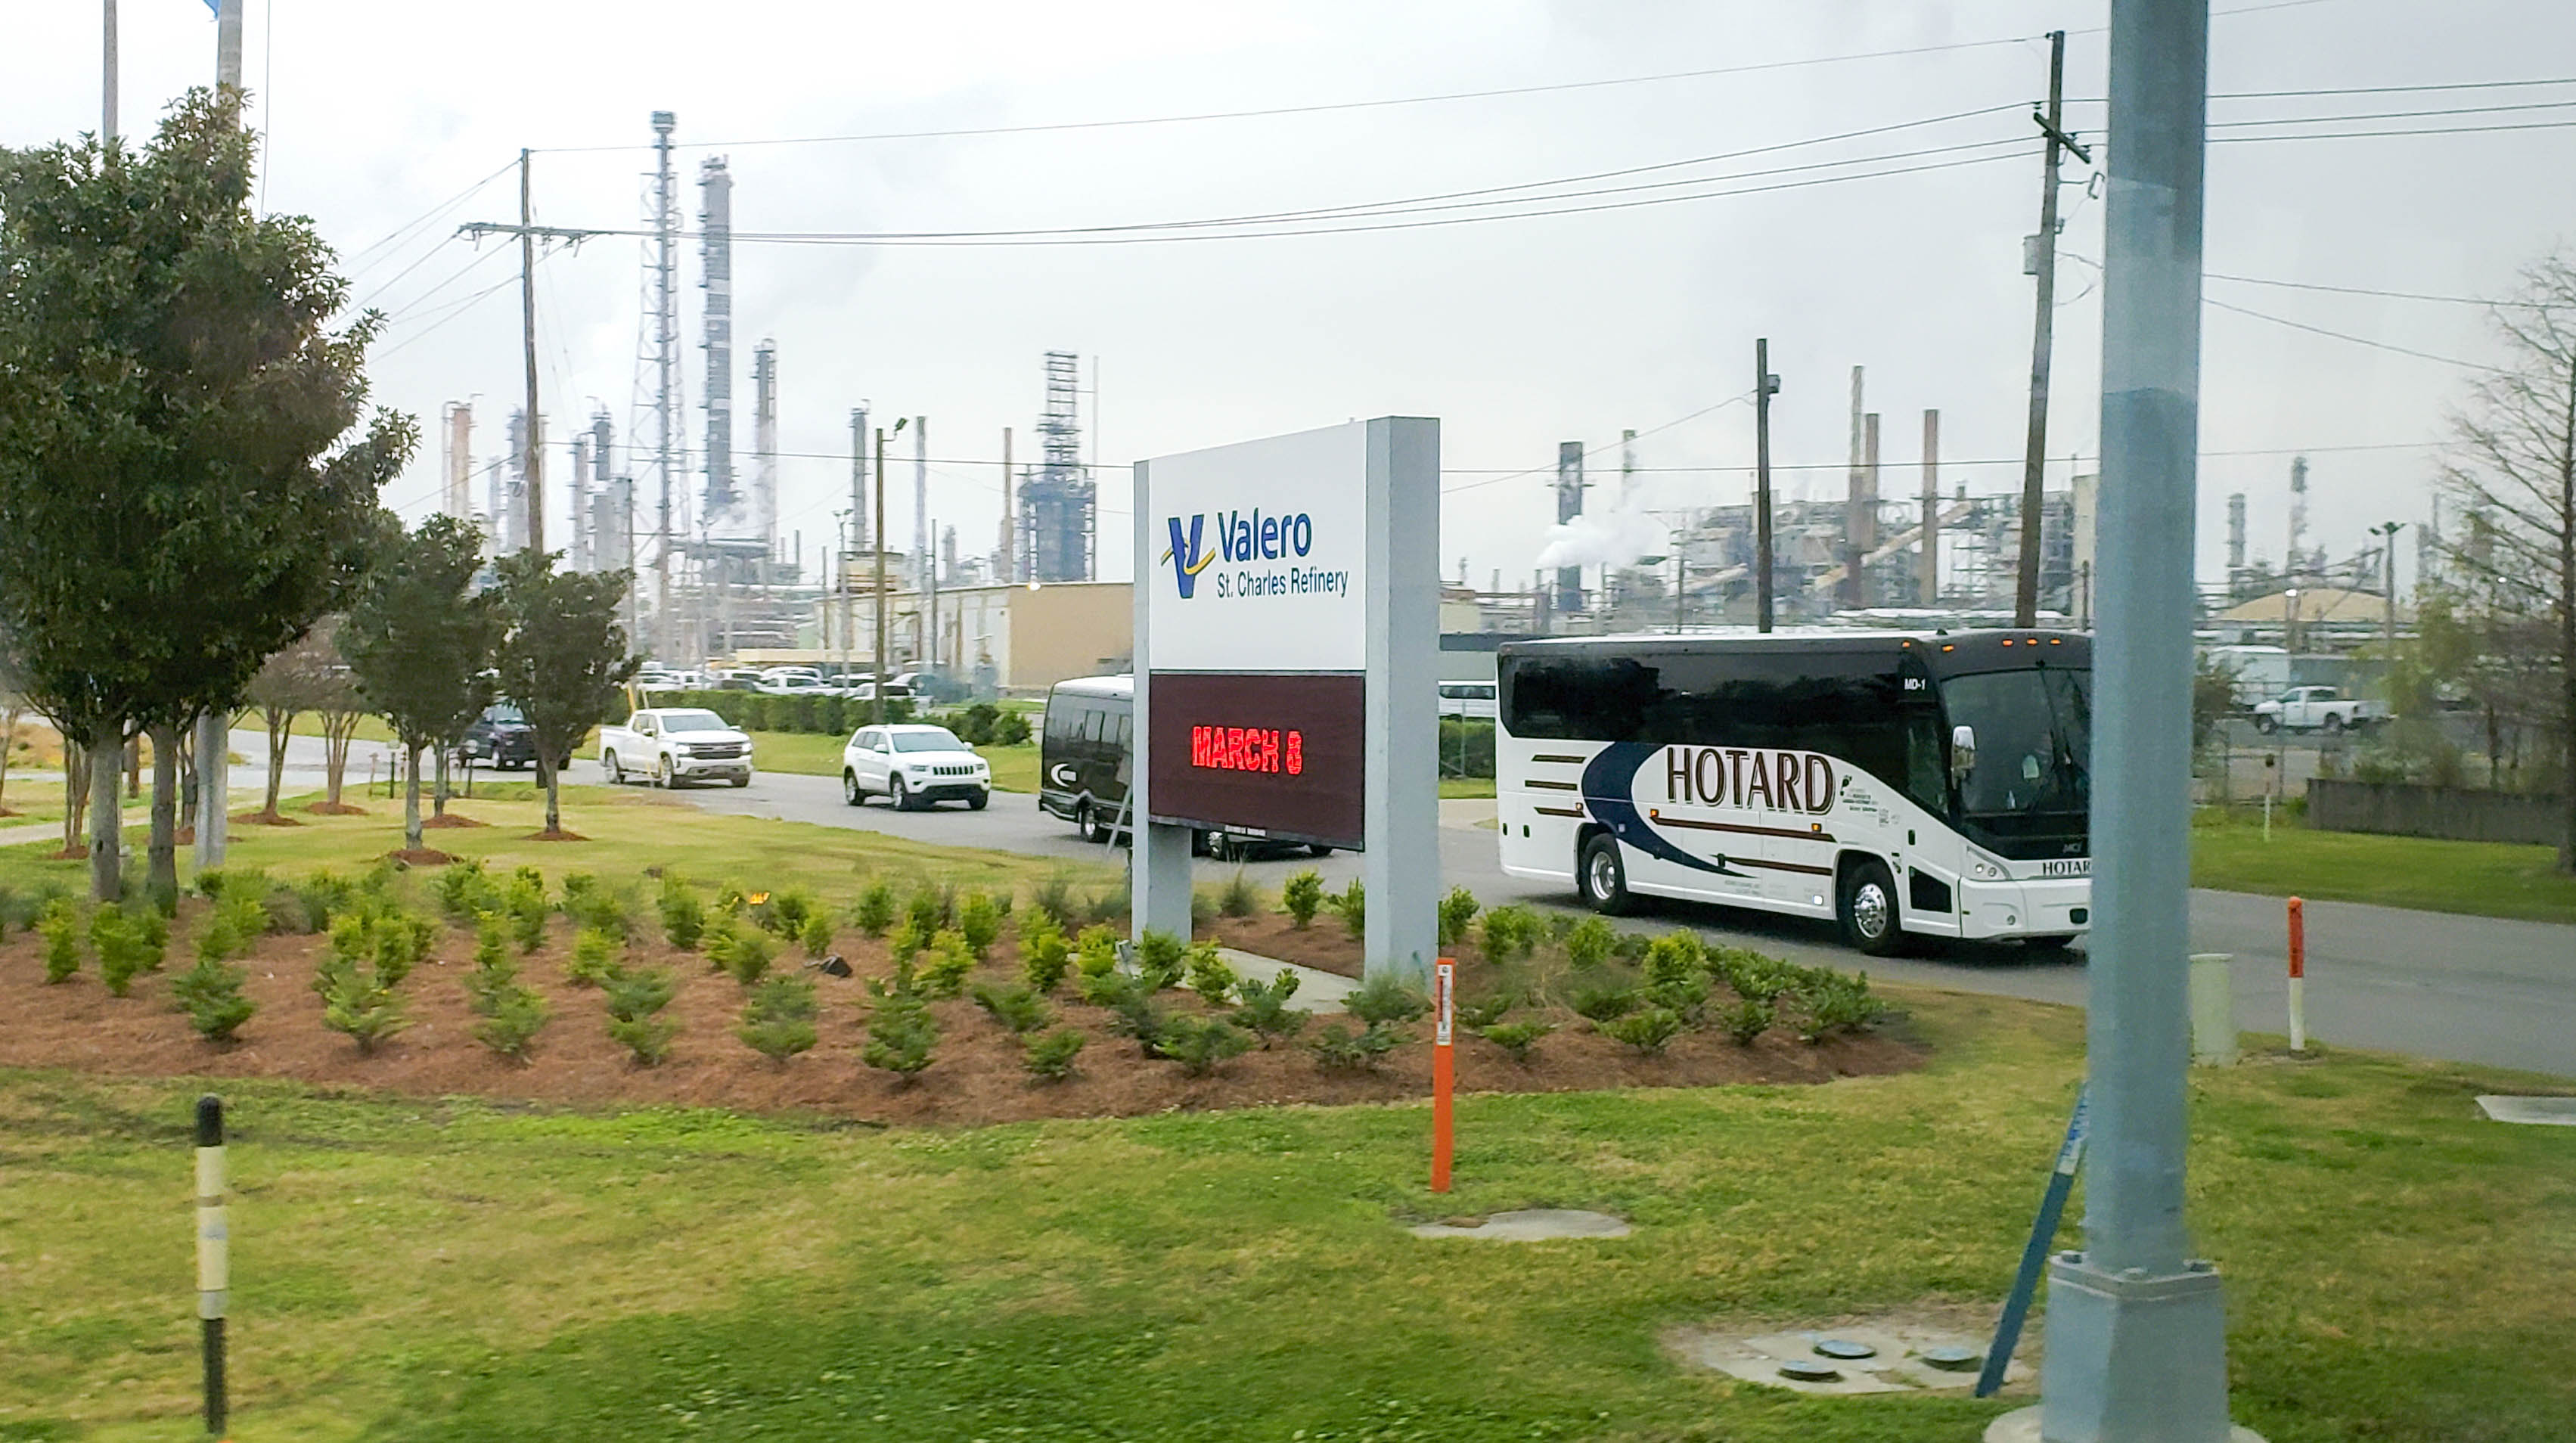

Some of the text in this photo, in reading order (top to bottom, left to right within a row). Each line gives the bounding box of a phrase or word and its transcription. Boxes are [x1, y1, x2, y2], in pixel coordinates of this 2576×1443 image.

[1218, 507, 1311, 563] Valero
[1218, 566, 1349, 598] St. Charles Refinery
[1904, 678, 1926, 690] MD-1
[1192, 726, 1302, 775] MARCH 8
[1667, 746, 1836, 815] HOTARD
[2042, 861, 2091, 875] HOTAR
